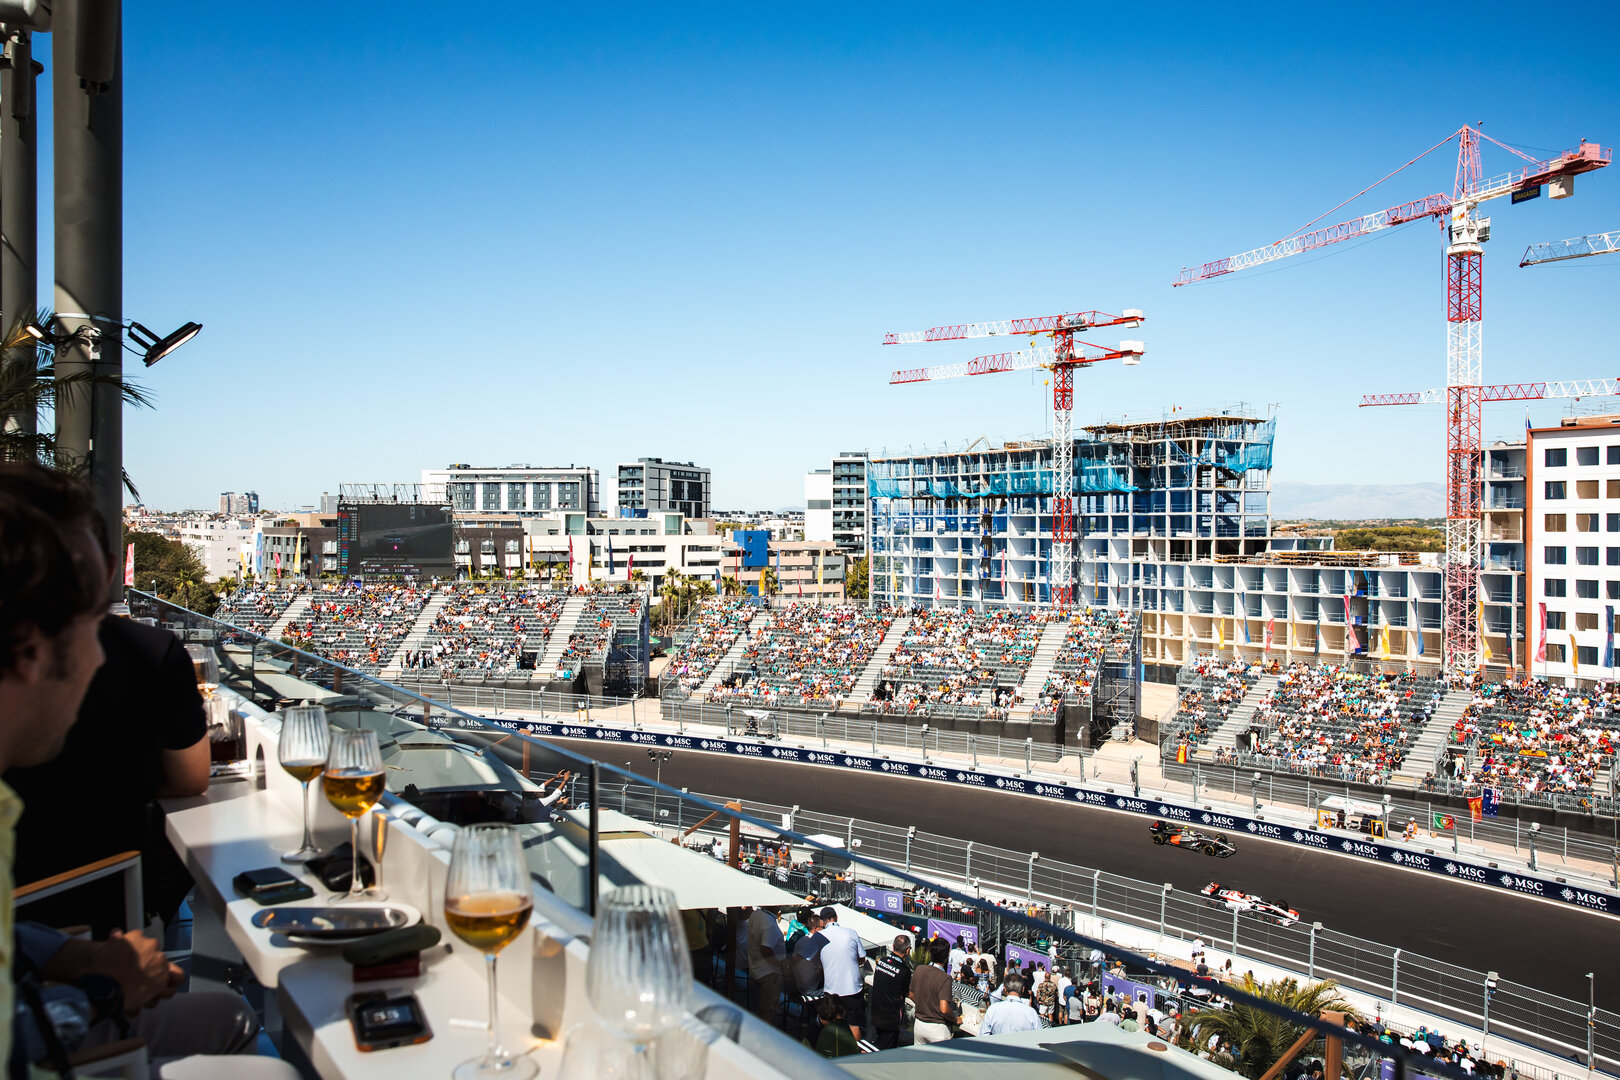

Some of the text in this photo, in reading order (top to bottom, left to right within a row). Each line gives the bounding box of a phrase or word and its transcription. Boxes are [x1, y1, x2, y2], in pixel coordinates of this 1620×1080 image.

[891, 763, 908, 771] MSC
[929, 769, 946, 777] MSC
[967, 774, 984, 782] MSC
[1006, 780, 1024, 789] MSC
[1045, 786, 1064, 795] MSC
[1086, 793, 1105, 802] MSC
[1127, 800, 1146, 809] MSC
[1170, 808, 1190, 817] MSC
[1213, 815, 1233, 825] MSC
[1259, 824, 1280, 834] MSC
[1305, 833, 1327, 844] MSC
[1354, 843, 1377, 855] MSC
[1405, 854, 1429, 866] MSC
[1459, 865, 1485, 878] MSC
[1515, 878, 1542, 891] MSC
[858, 896, 876, 907] 1-23
[1577, 892, 1606, 906] MSC
[1577, 901, 1607, 910] CRUISES
[960, 929, 972, 937] GD
[1010, 950, 1020, 958] GD
